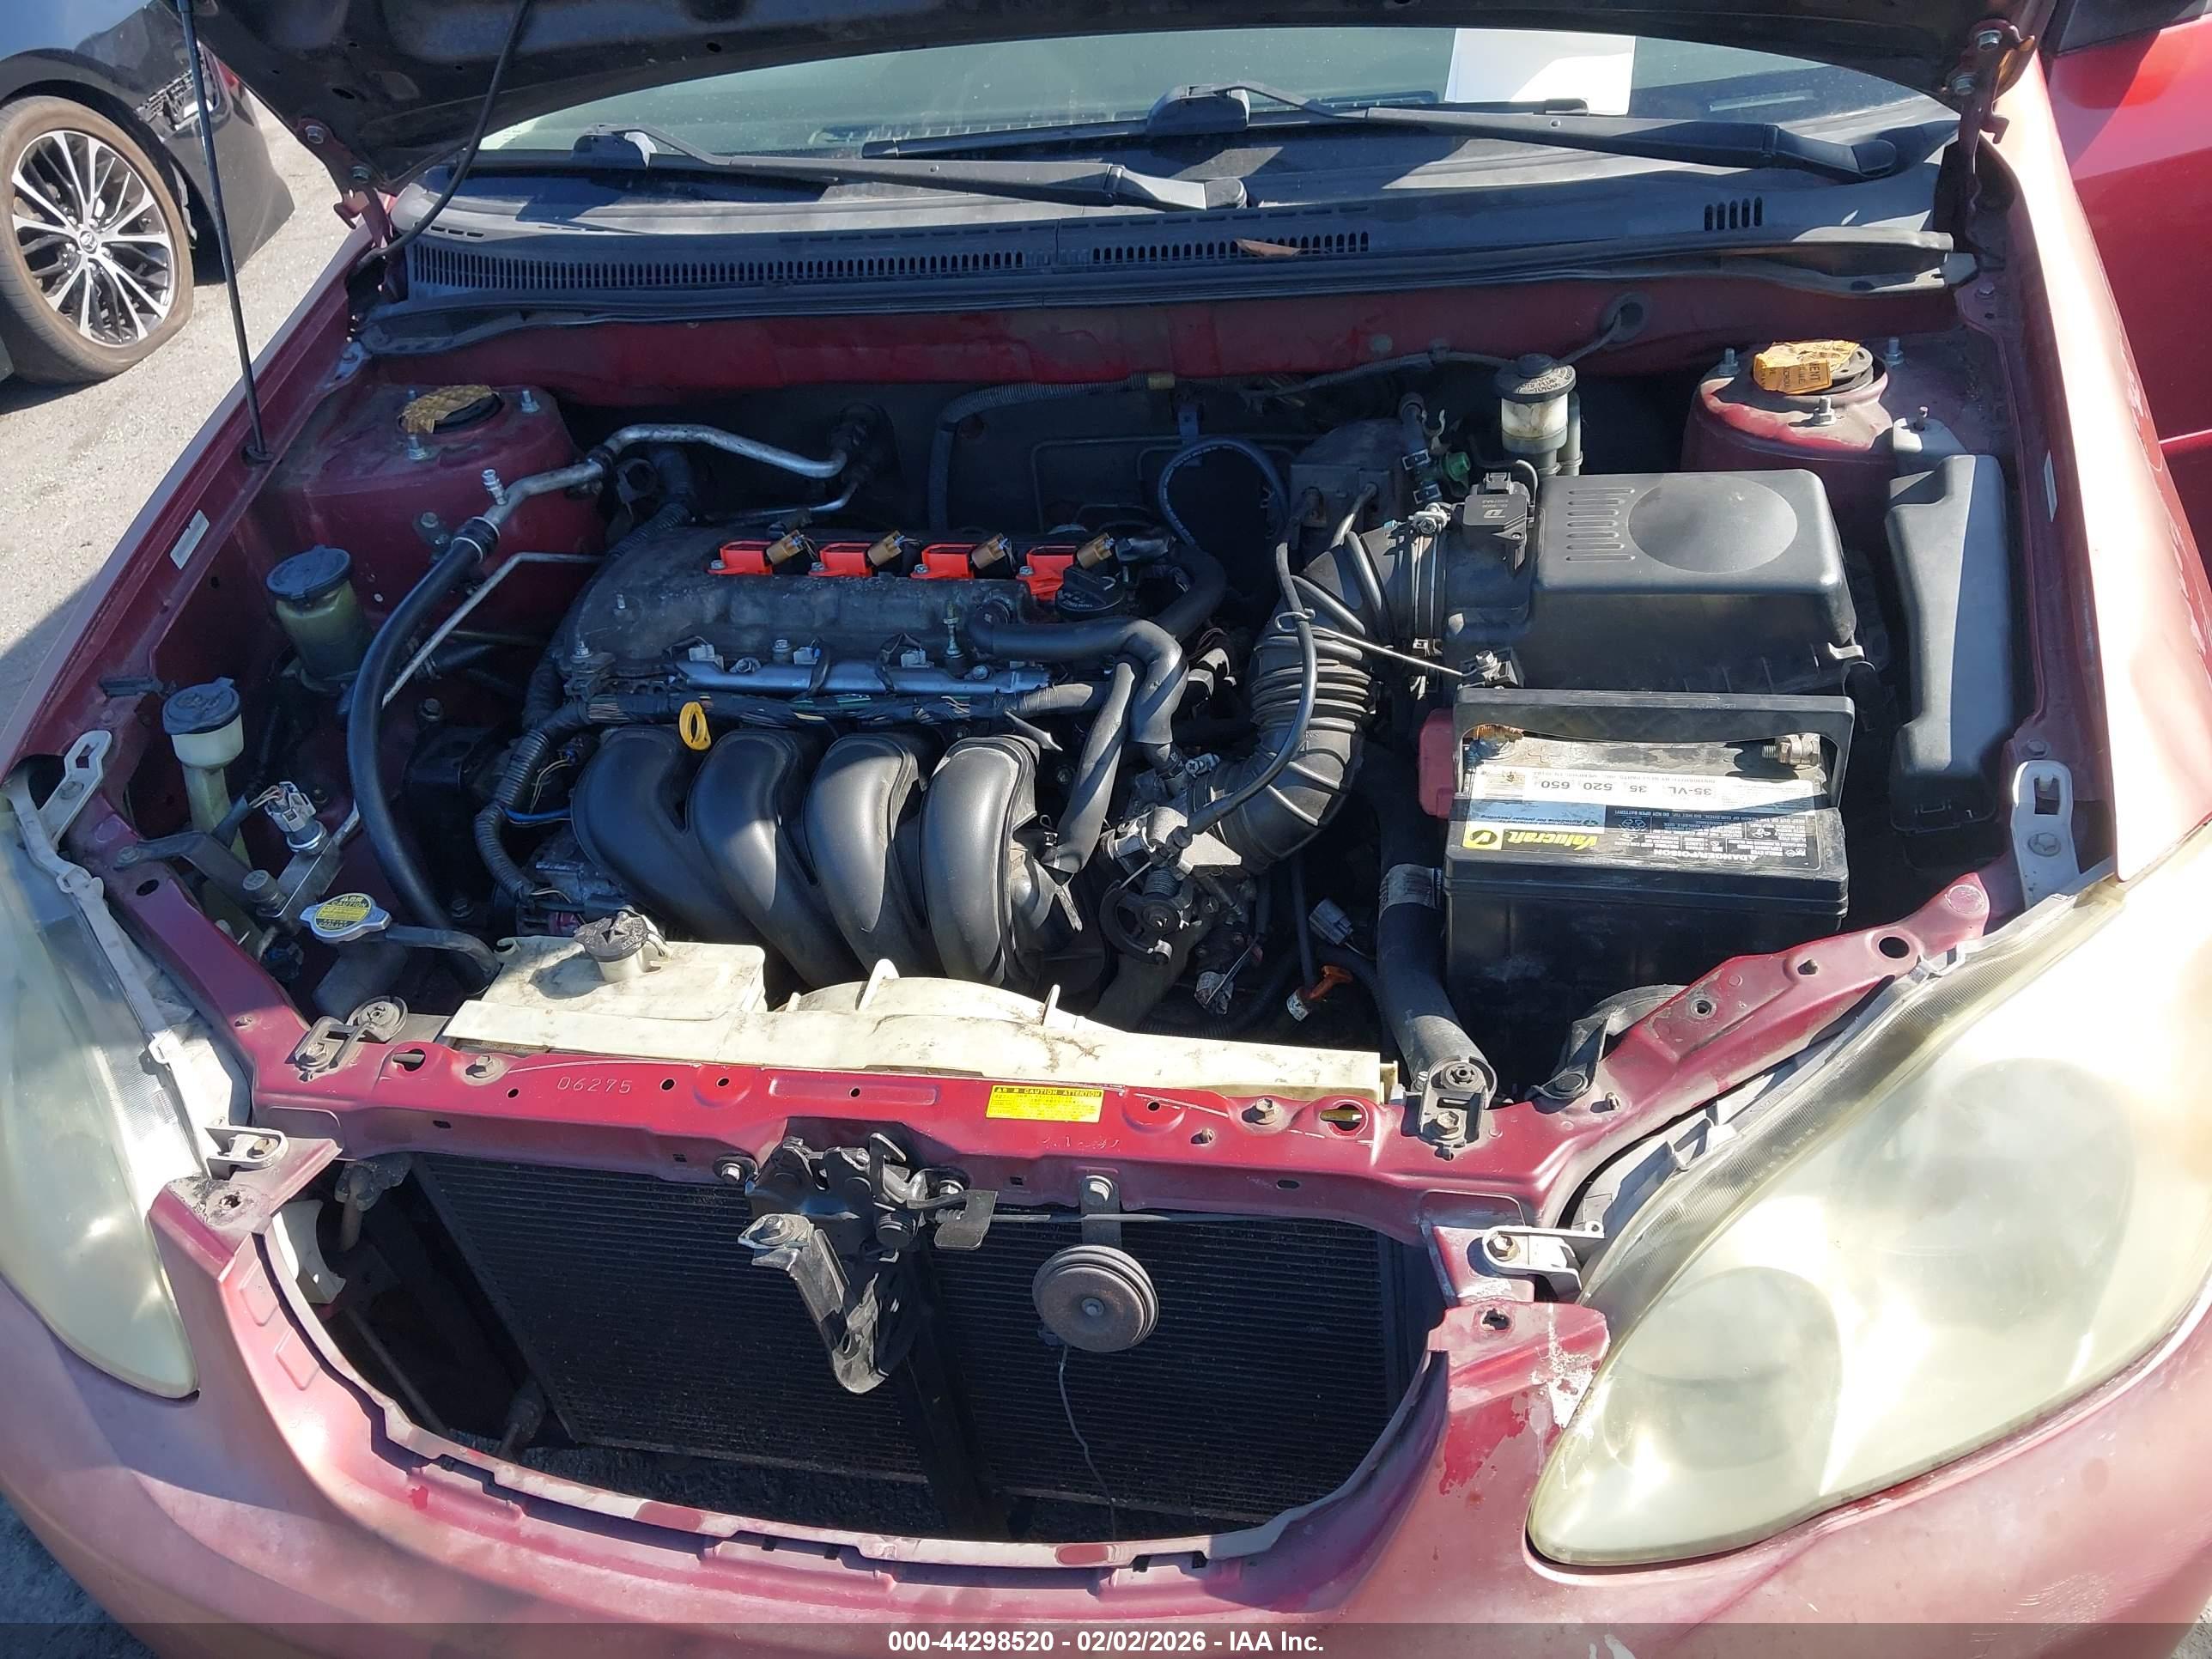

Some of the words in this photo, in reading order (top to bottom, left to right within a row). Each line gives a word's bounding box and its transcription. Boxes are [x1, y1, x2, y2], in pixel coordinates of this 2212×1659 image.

[1540, 780, 1570, 789] 650
[1583, 782, 1613, 791] 520
[1629, 785, 1647, 793] 35
[1668, 787, 1711, 796] 35-VL
[1508, 831, 1598, 850] Valucraft
[1654, 849, 1747, 860] DANGER/POISON
[557, 1077, 633, 1093] 06275
